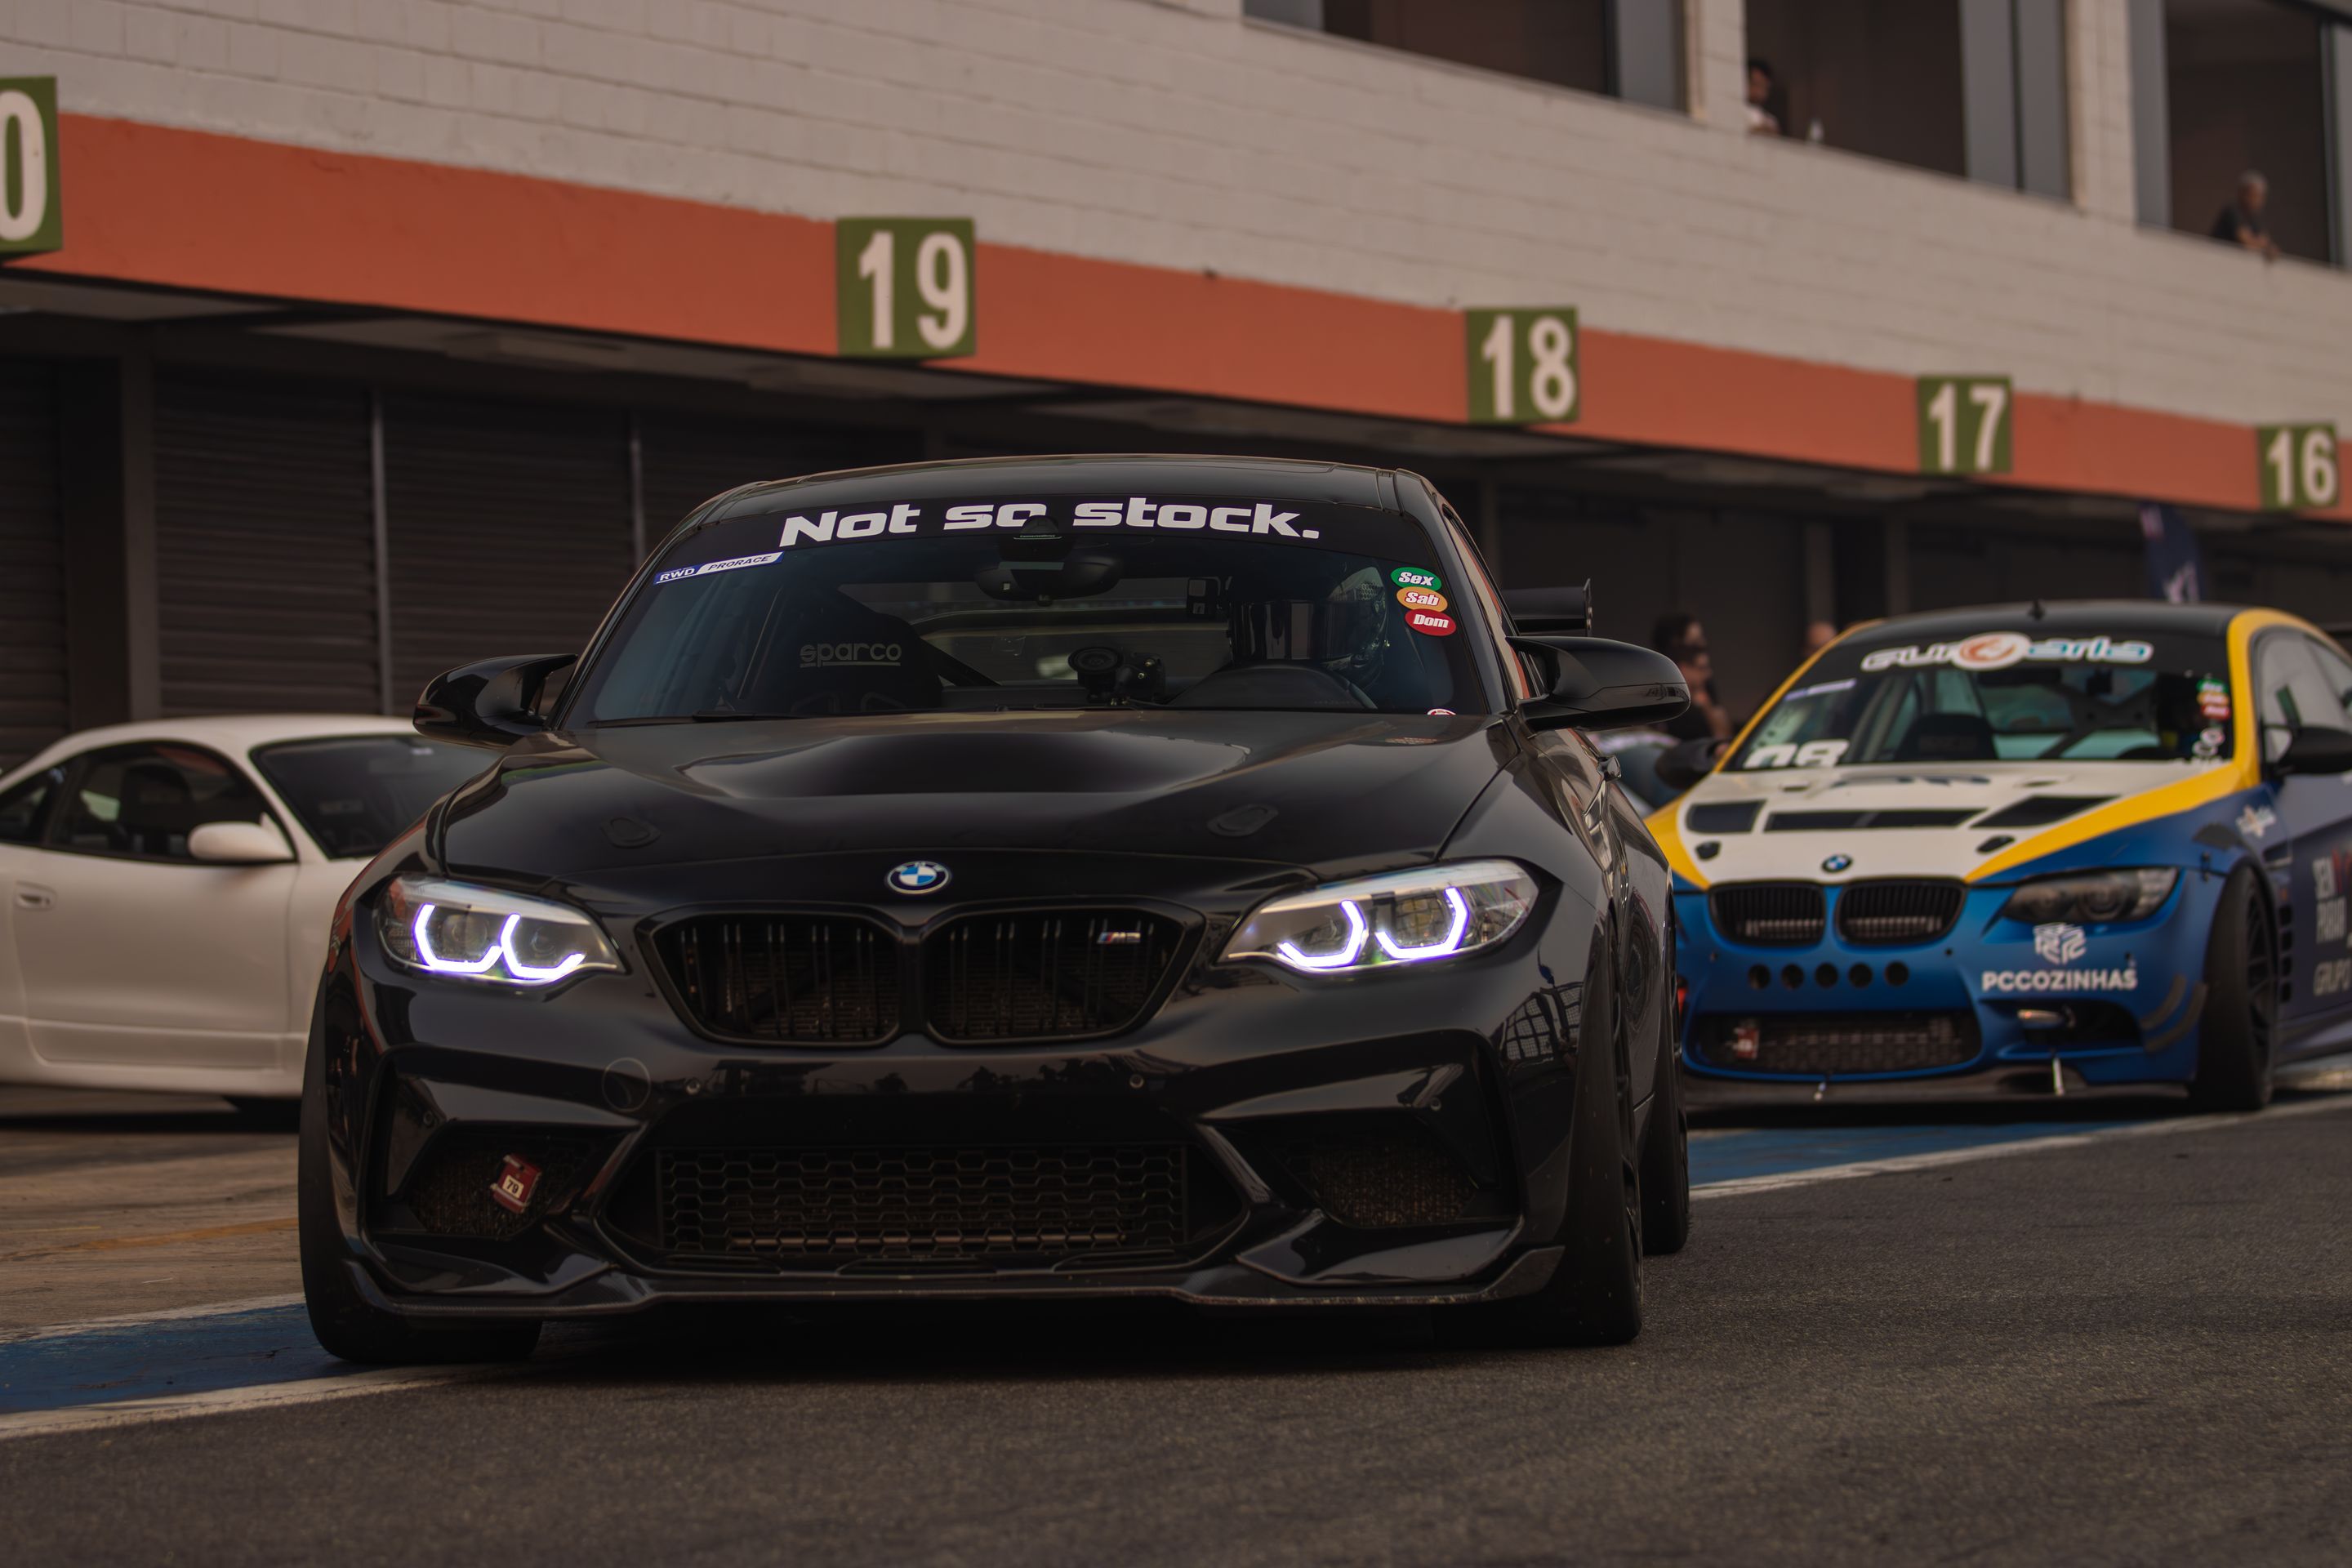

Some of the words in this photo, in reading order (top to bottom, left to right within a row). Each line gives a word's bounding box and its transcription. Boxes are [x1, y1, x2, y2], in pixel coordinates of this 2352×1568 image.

[859, 231, 969, 350] 19
[1482, 314, 1576, 418] 18
[1928, 383, 2006, 472] 17
[2267, 430, 2337, 506] 16
[779, 504, 921, 547] Not
[943, 503, 1047, 530] so
[1072, 497, 1320, 539] stock.
[660, 568, 695, 581] RWD
[708, 555, 773, 571] PRORACE
[1398, 572, 1435, 586] Sex
[1405, 592, 1439, 606] Sab
[1413, 614, 1449, 628] Dom
[800, 643, 902, 667] sparco
[1982, 969, 2138, 991] PCCOZINHAS
[506, 1178, 519, 1194] 79
